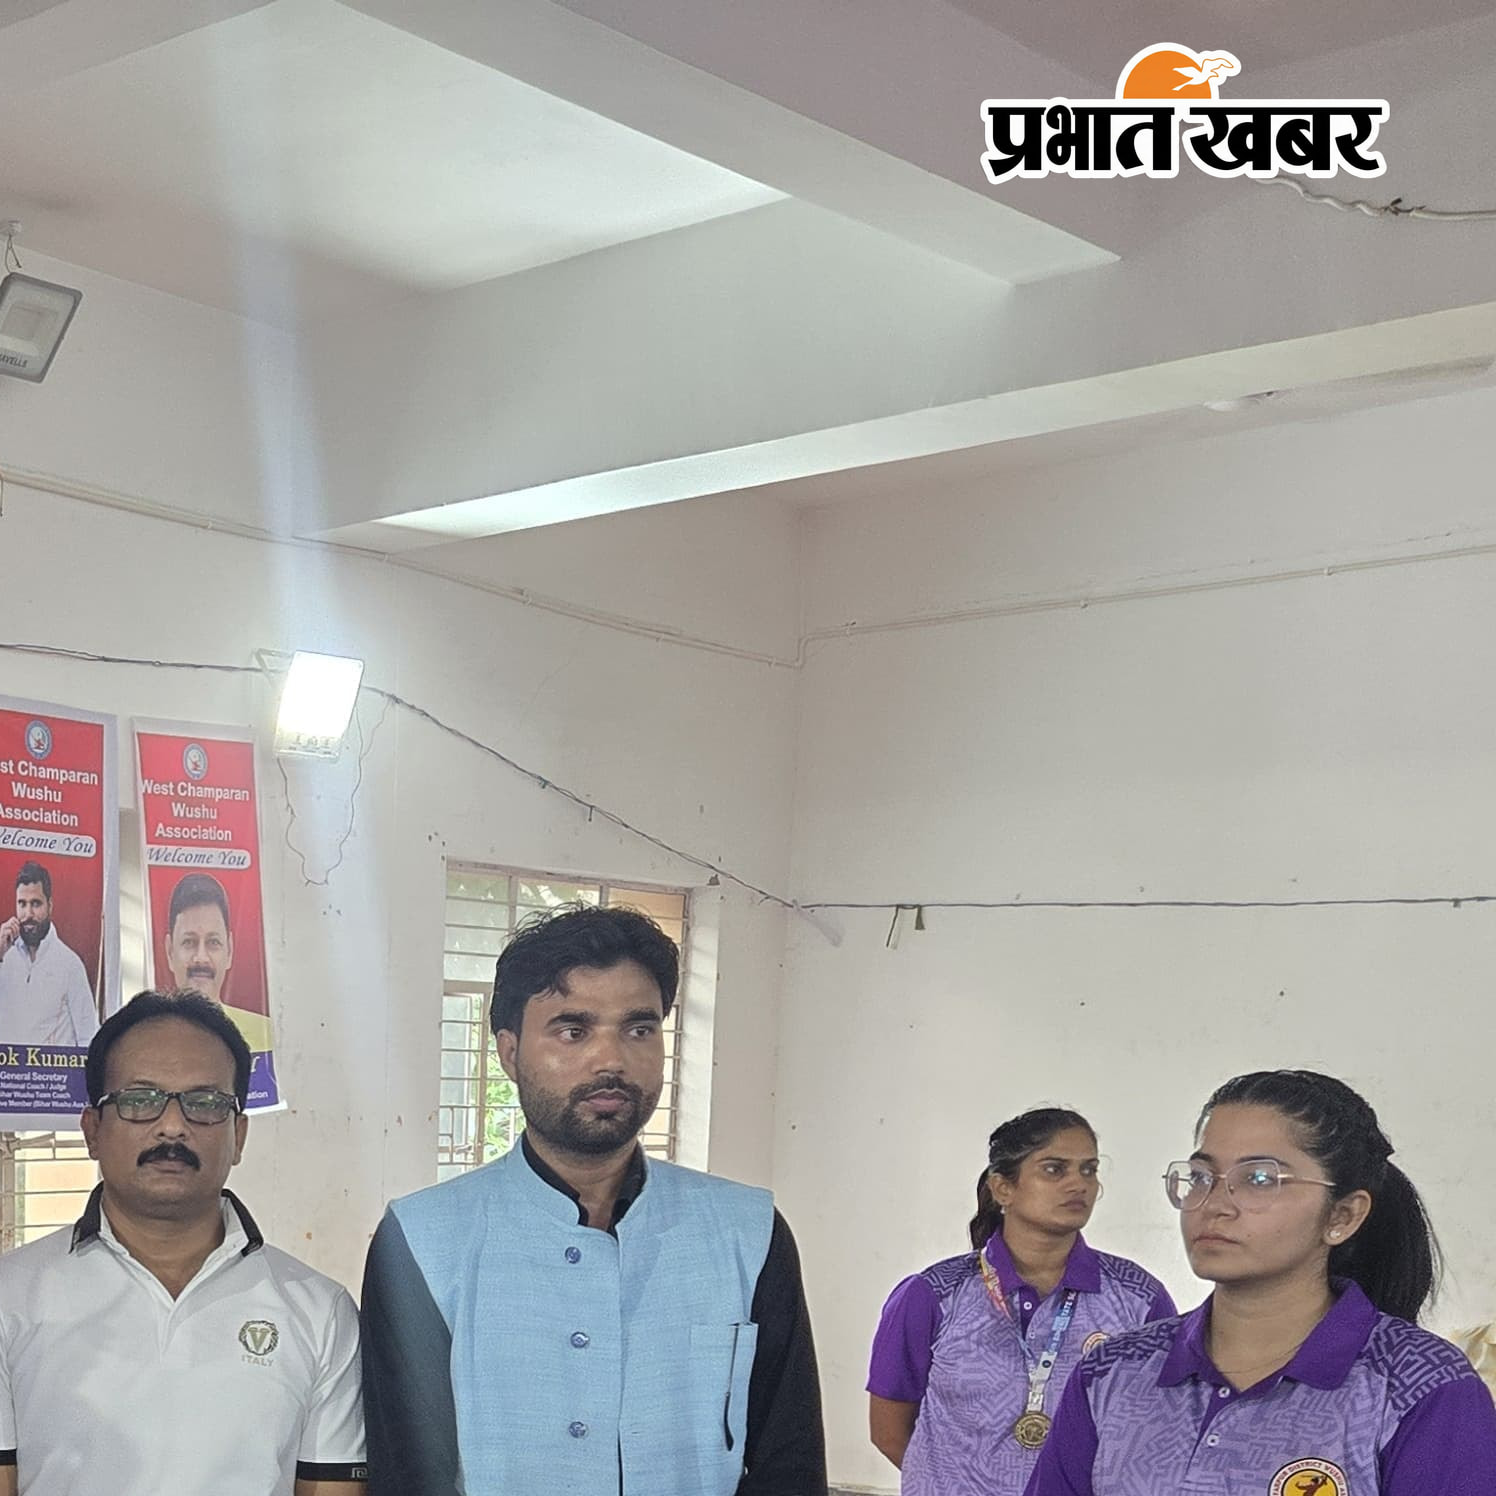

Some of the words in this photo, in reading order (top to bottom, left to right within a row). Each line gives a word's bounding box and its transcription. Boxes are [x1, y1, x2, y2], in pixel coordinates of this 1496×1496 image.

[17, 760, 99, 785] Champaran
[11, 781, 62, 803] Wushu
[142, 779, 175, 796] West
[177, 782, 250, 802] Champaran
[171, 802, 218, 819] Wushu
[155, 823, 232, 841] Association
[62, 837, 94, 854] You
[146, 847, 214, 864] Welcome
[218, 850, 247, 866] You
[26, 1047, 88, 1067] Kumar
[0, 1071, 31, 1081] General
[32, 1072, 68, 1083] Secretary
[241, 1354, 274, 1367] ITALY
